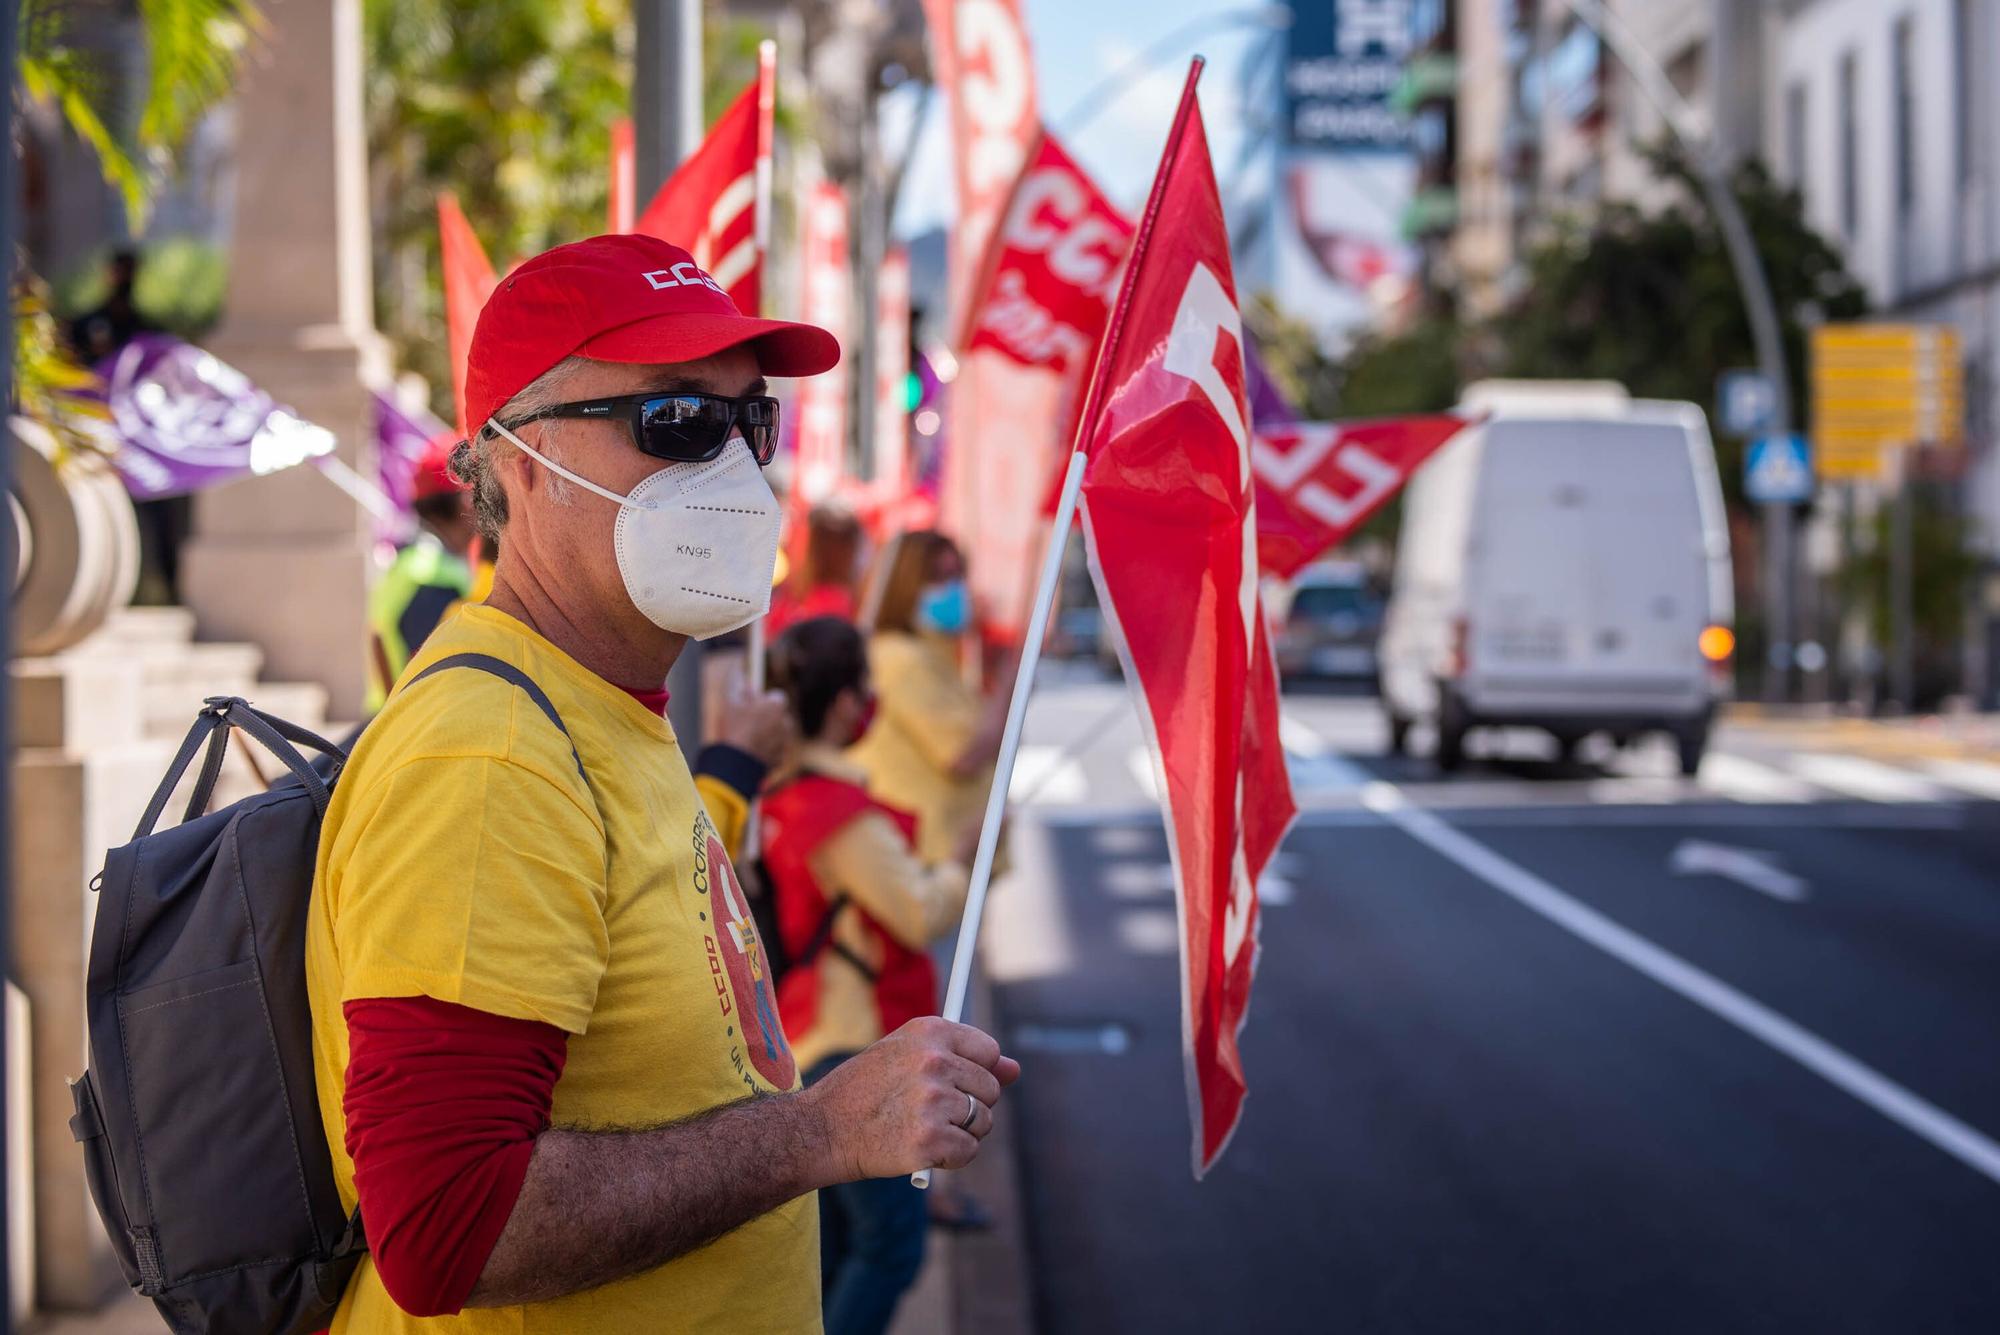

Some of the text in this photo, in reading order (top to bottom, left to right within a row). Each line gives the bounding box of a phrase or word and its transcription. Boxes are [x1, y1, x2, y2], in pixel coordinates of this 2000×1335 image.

[676, 544, 712, 560] KN95
[704, 934, 731, 1017] CCOO
[731, 1045, 762, 1097] UN PU
